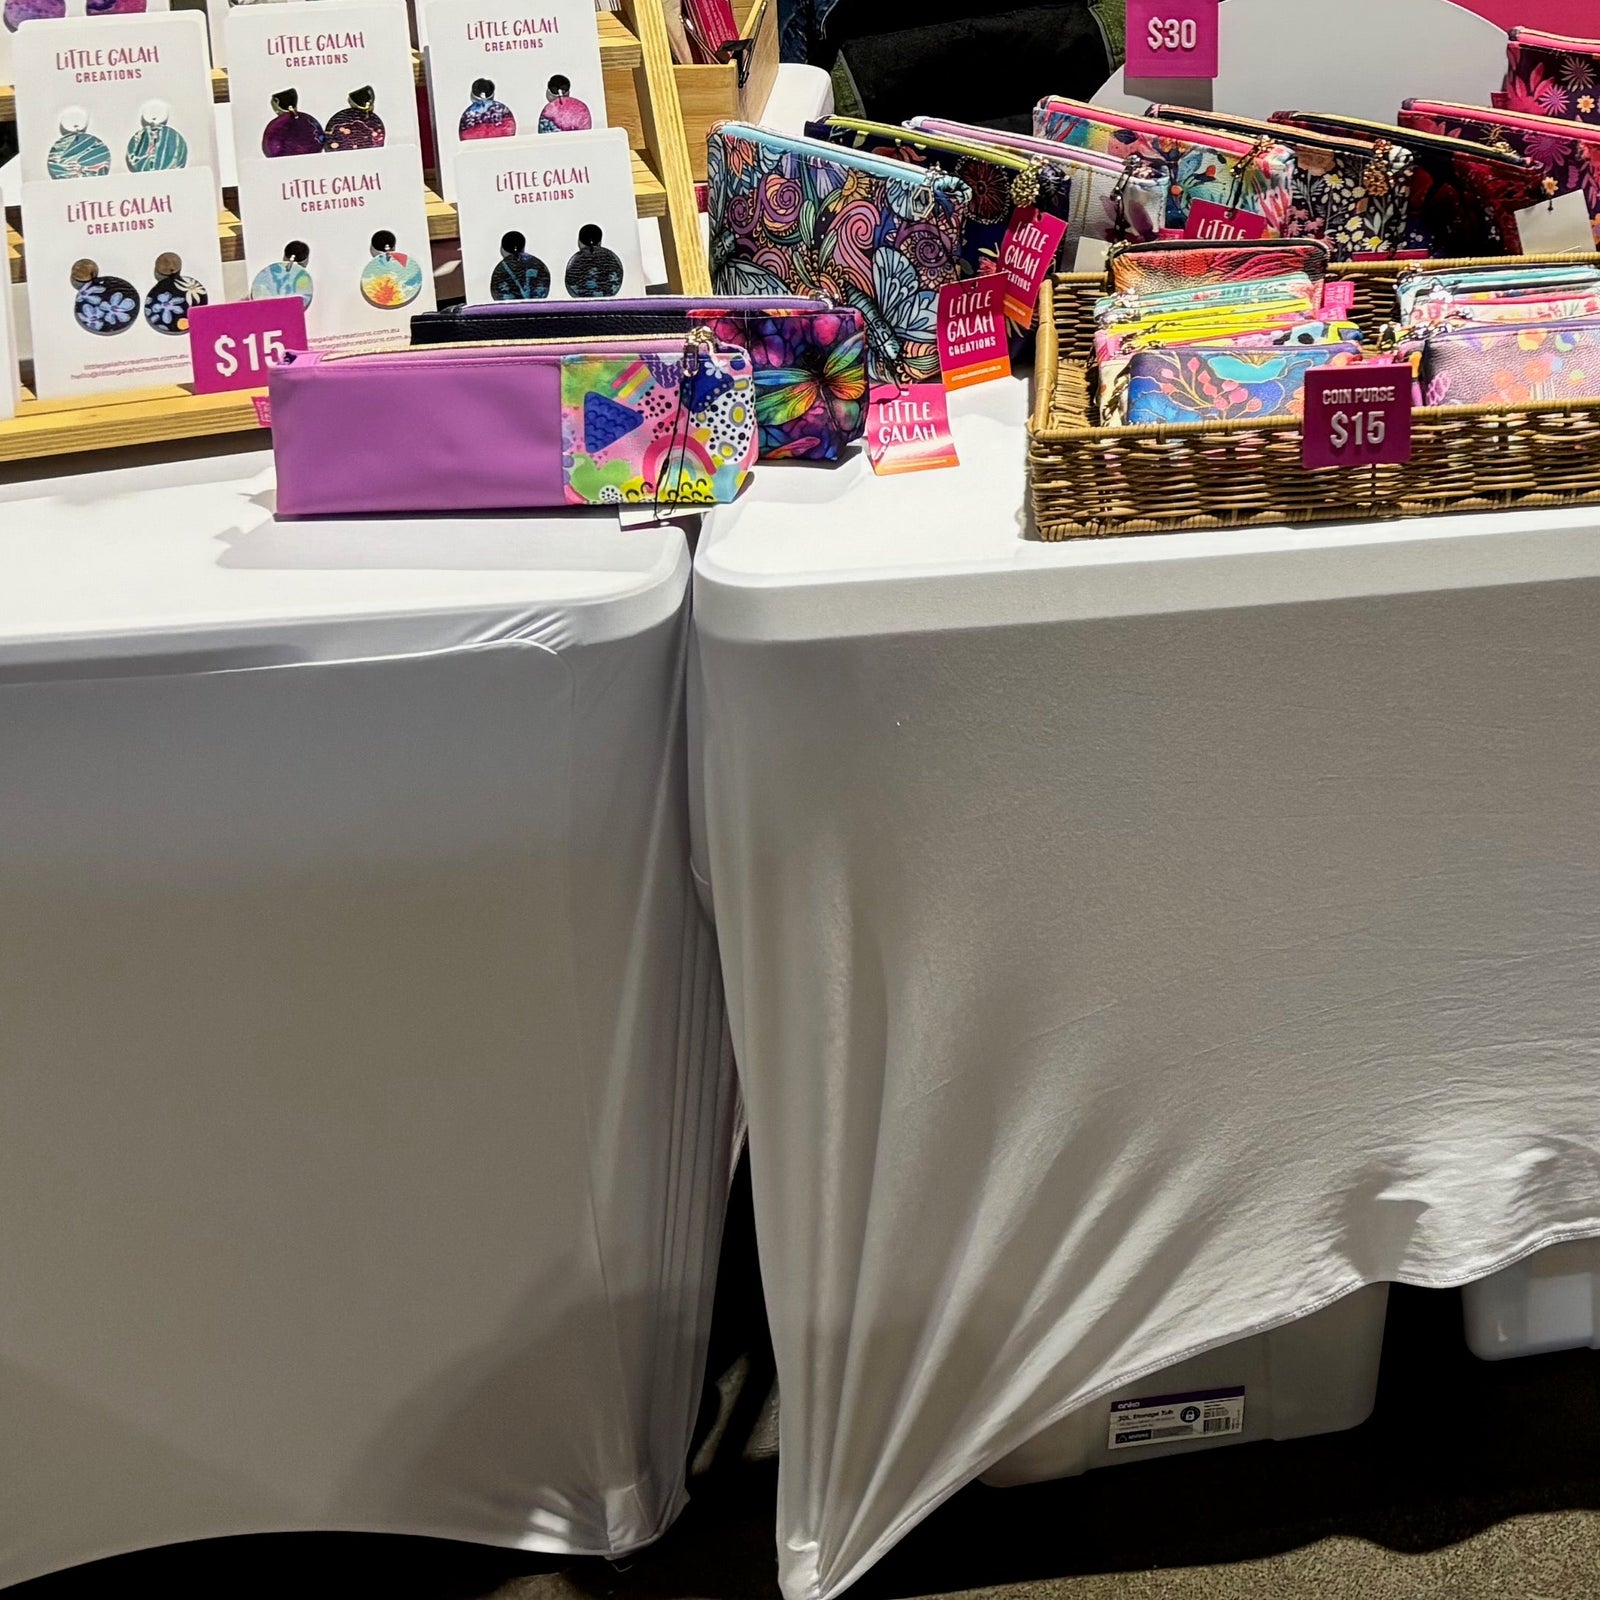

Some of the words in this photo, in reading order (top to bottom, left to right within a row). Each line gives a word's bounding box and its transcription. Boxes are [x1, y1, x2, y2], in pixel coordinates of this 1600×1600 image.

[513, 16, 559, 36] GALAH
[1146, 16, 1197, 50] $30
[316, 31, 365, 51] GALAH
[485, 38, 544, 52] CREATIONS
[108, 45, 159, 66] GALAH
[286, 53, 349, 67] CREATIONS
[76, 68, 142, 83] CREATIONS
[332, 172, 381, 194] GALAH
[543, 166, 590, 187] GALAH
[120, 195, 172, 217] GALAH
[301, 196, 365, 212] CREATIONS
[514, 189, 574, 204] CREATIONS
[87, 218, 155, 235] CREATIONS
[1004, 245, 1041, 280] GALAH
[947, 311, 996, 343] GALAH
[214, 329, 285, 377] $15
[948, 335, 996, 357] CREATIONS
[1322, 388, 1353, 405] COIN
[1354, 386, 1396, 403] PURSE
[878, 423, 938, 444] GALAH
[1330, 410, 1386, 448] $15
